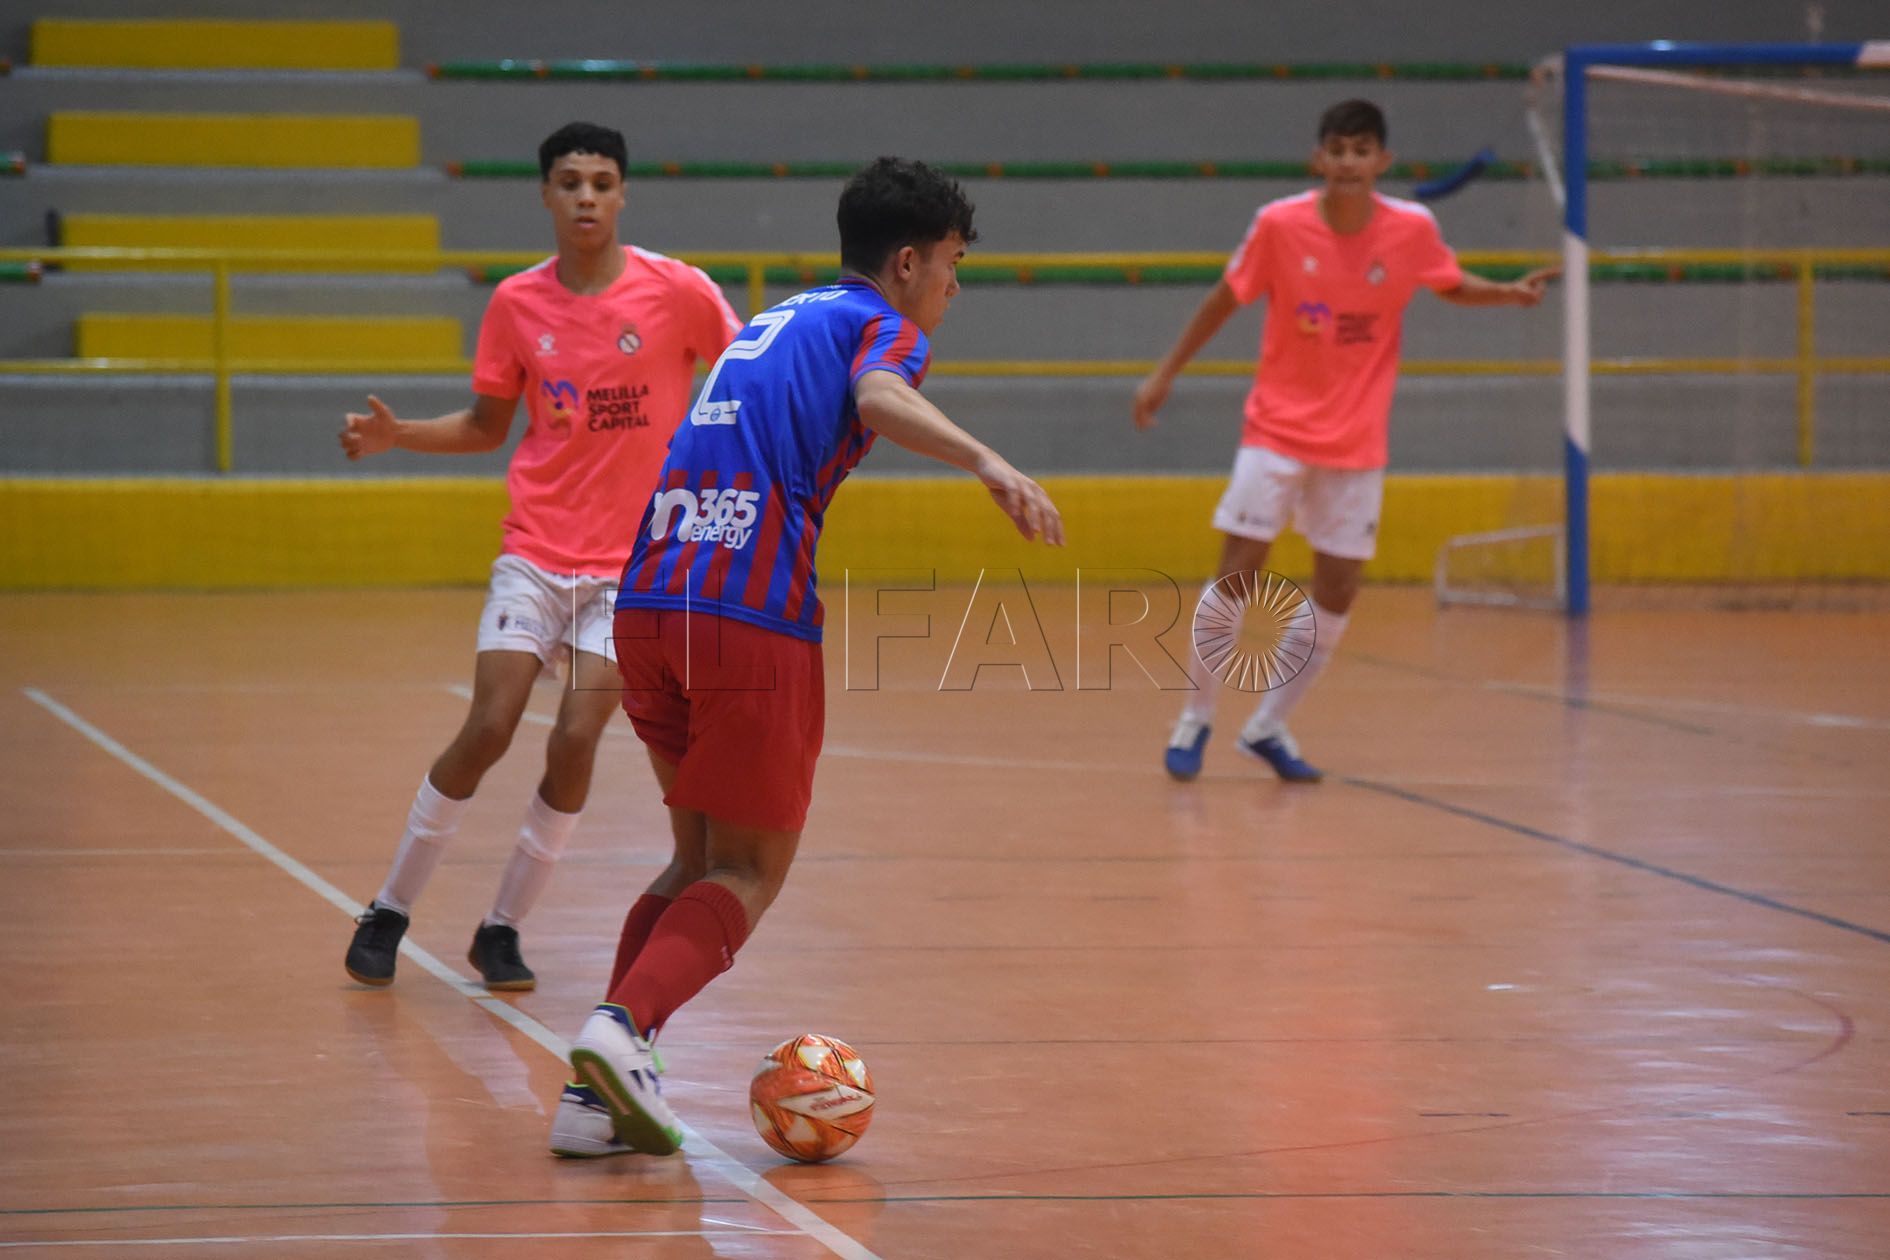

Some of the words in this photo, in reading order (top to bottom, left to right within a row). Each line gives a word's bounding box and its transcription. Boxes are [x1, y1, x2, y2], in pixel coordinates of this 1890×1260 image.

[690, 309, 796, 426] 2
[586, 384, 650, 401] MELILLA
[588, 401, 640, 415] SPORT
[588, 415, 651, 431] CAPITAL
[690, 525, 753, 550] energy
